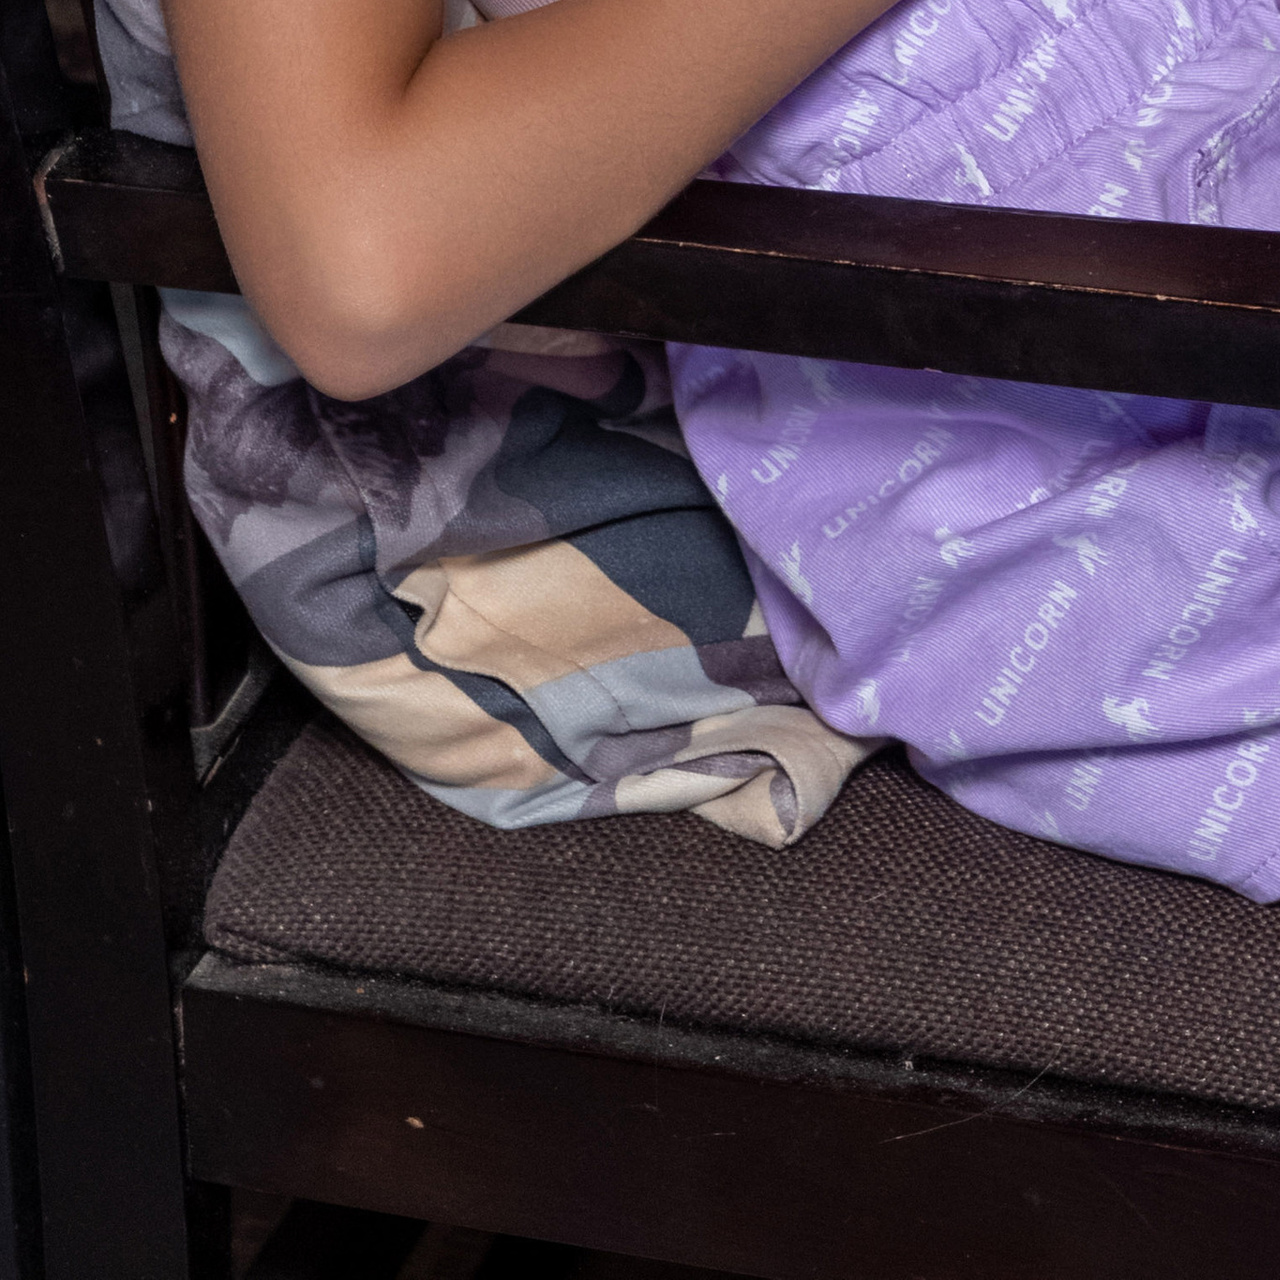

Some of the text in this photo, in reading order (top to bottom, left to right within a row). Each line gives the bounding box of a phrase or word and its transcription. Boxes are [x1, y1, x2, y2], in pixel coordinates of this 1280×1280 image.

[974, 580, 1077, 727] UNICORN
[1142, 549, 1247, 680] UNICORN
[1187, 738, 1271, 862] UNICOR
